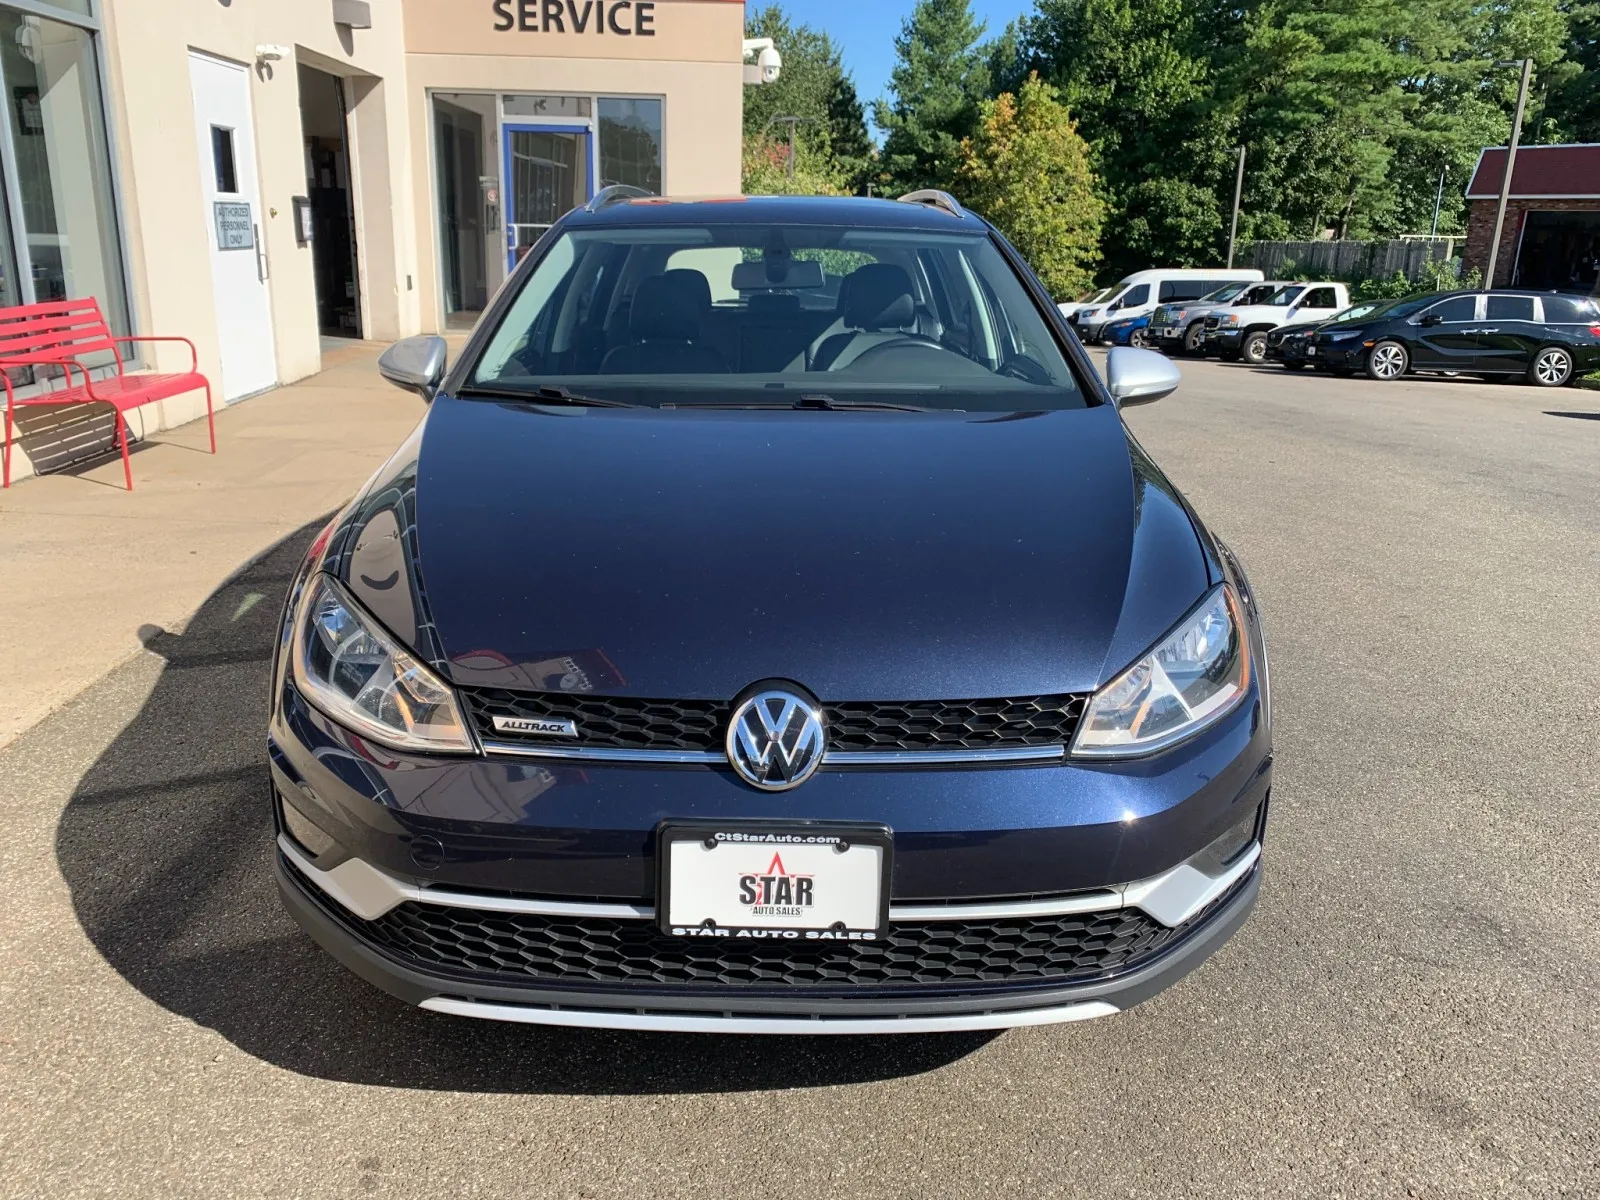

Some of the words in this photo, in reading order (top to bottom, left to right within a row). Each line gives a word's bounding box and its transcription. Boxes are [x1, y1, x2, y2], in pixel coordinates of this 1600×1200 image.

[492, 0, 655, 36] SERVICE
[218, 206, 249, 217] AUTHORIZED
[220, 221, 250, 231] PERSONNEL
[229, 234, 243, 244] ONLY
[502, 721, 565, 732] ALLTRACK
[714, 832, 841, 844] CtStarAuto.com
[739, 875, 814, 906] STAR
[752, 906, 775, 915] AUTO
[776, 906, 801, 916] SALES
[672, 927, 730, 938] STAR
[736, 929, 799, 939] AUTO
[805, 931, 877, 940] SALES
